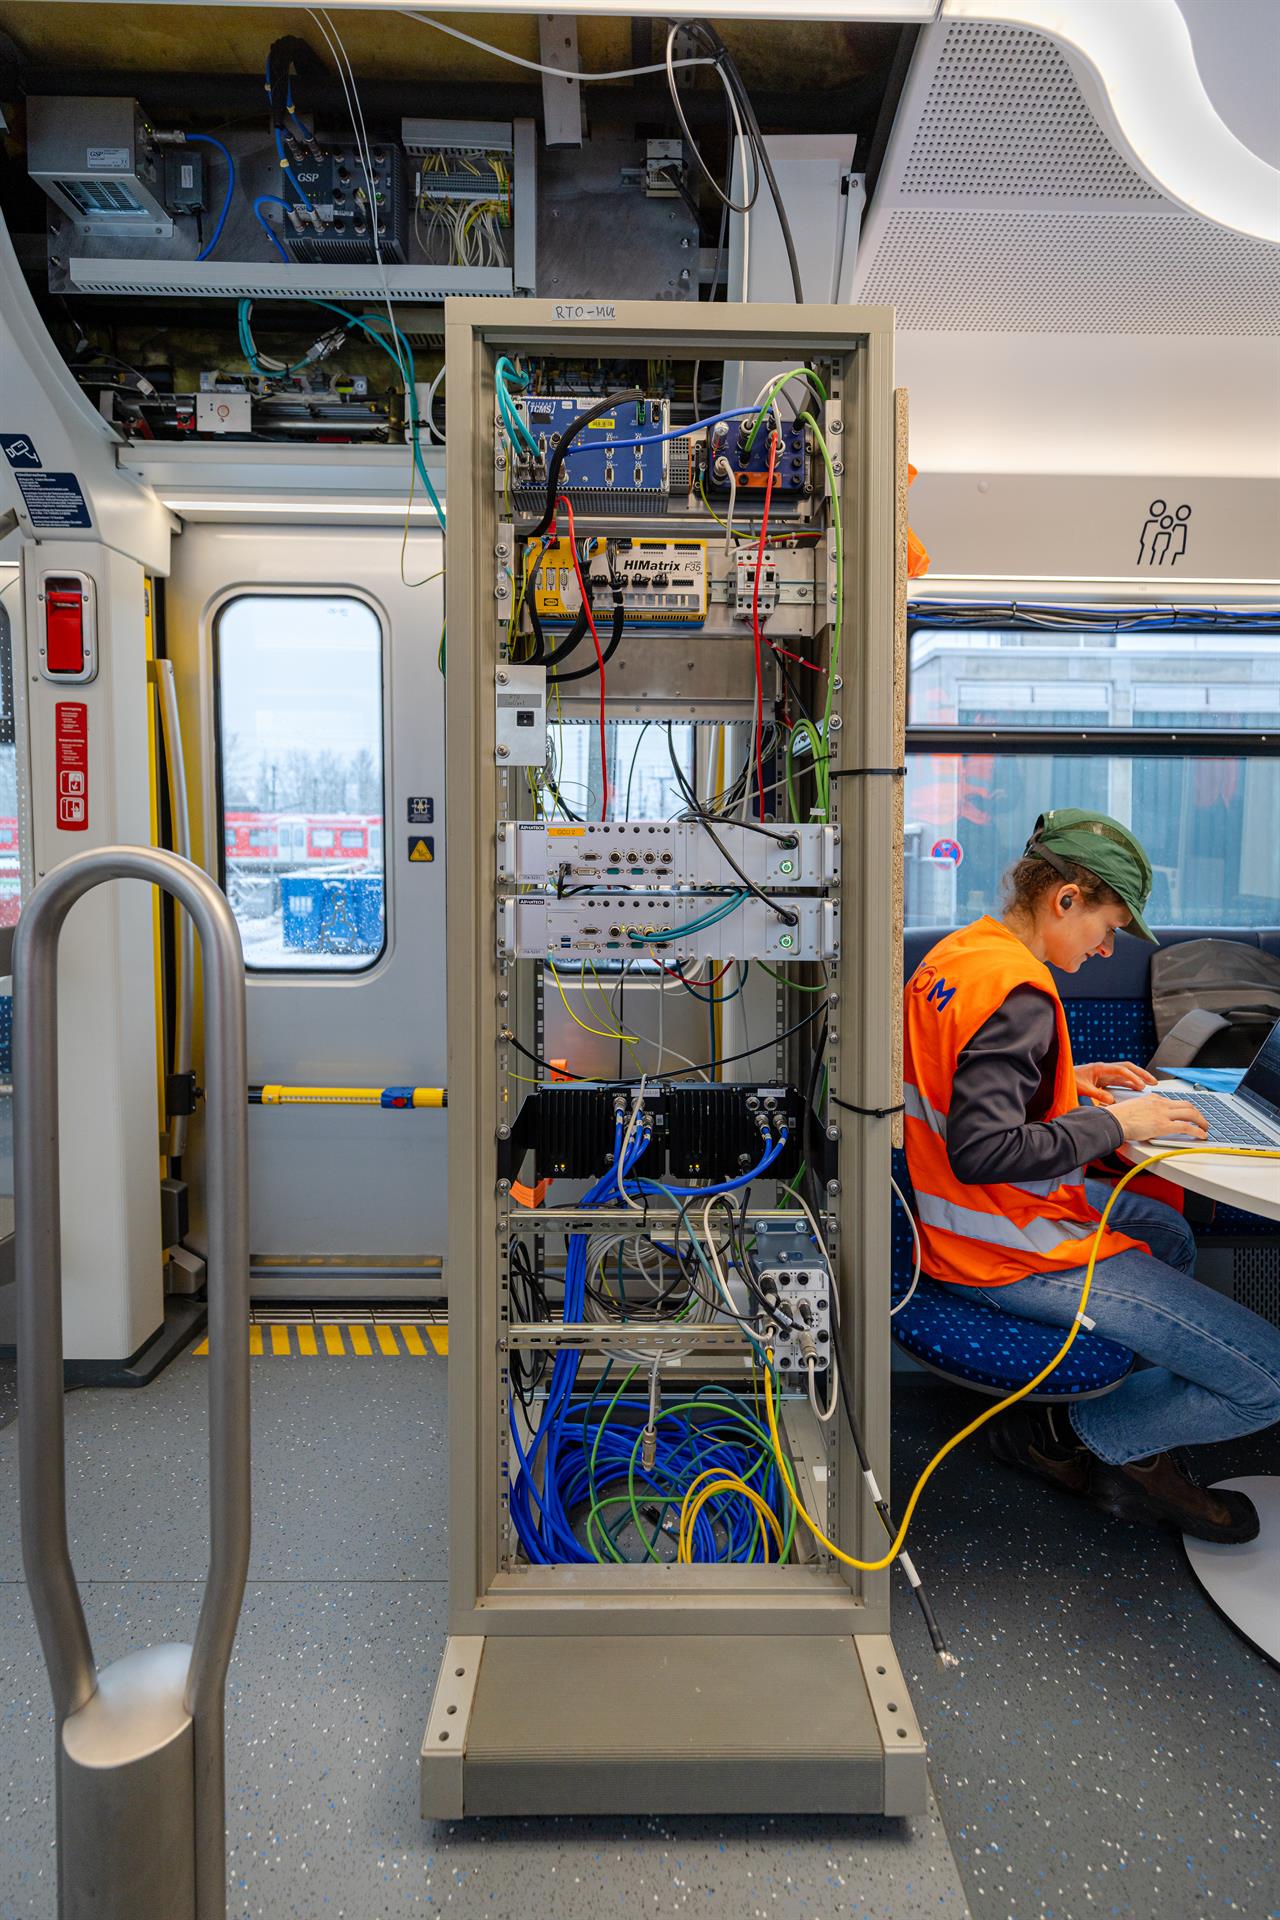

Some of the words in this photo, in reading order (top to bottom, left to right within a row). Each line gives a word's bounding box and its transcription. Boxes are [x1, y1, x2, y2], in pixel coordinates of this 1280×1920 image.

[297, 173, 319, 182] GSP
[530, 405, 552, 413] TCMS
[623, 560, 681, 571] HIMatrix
[684, 563, 701, 571] F35
[912, 962, 957, 1012] OM
